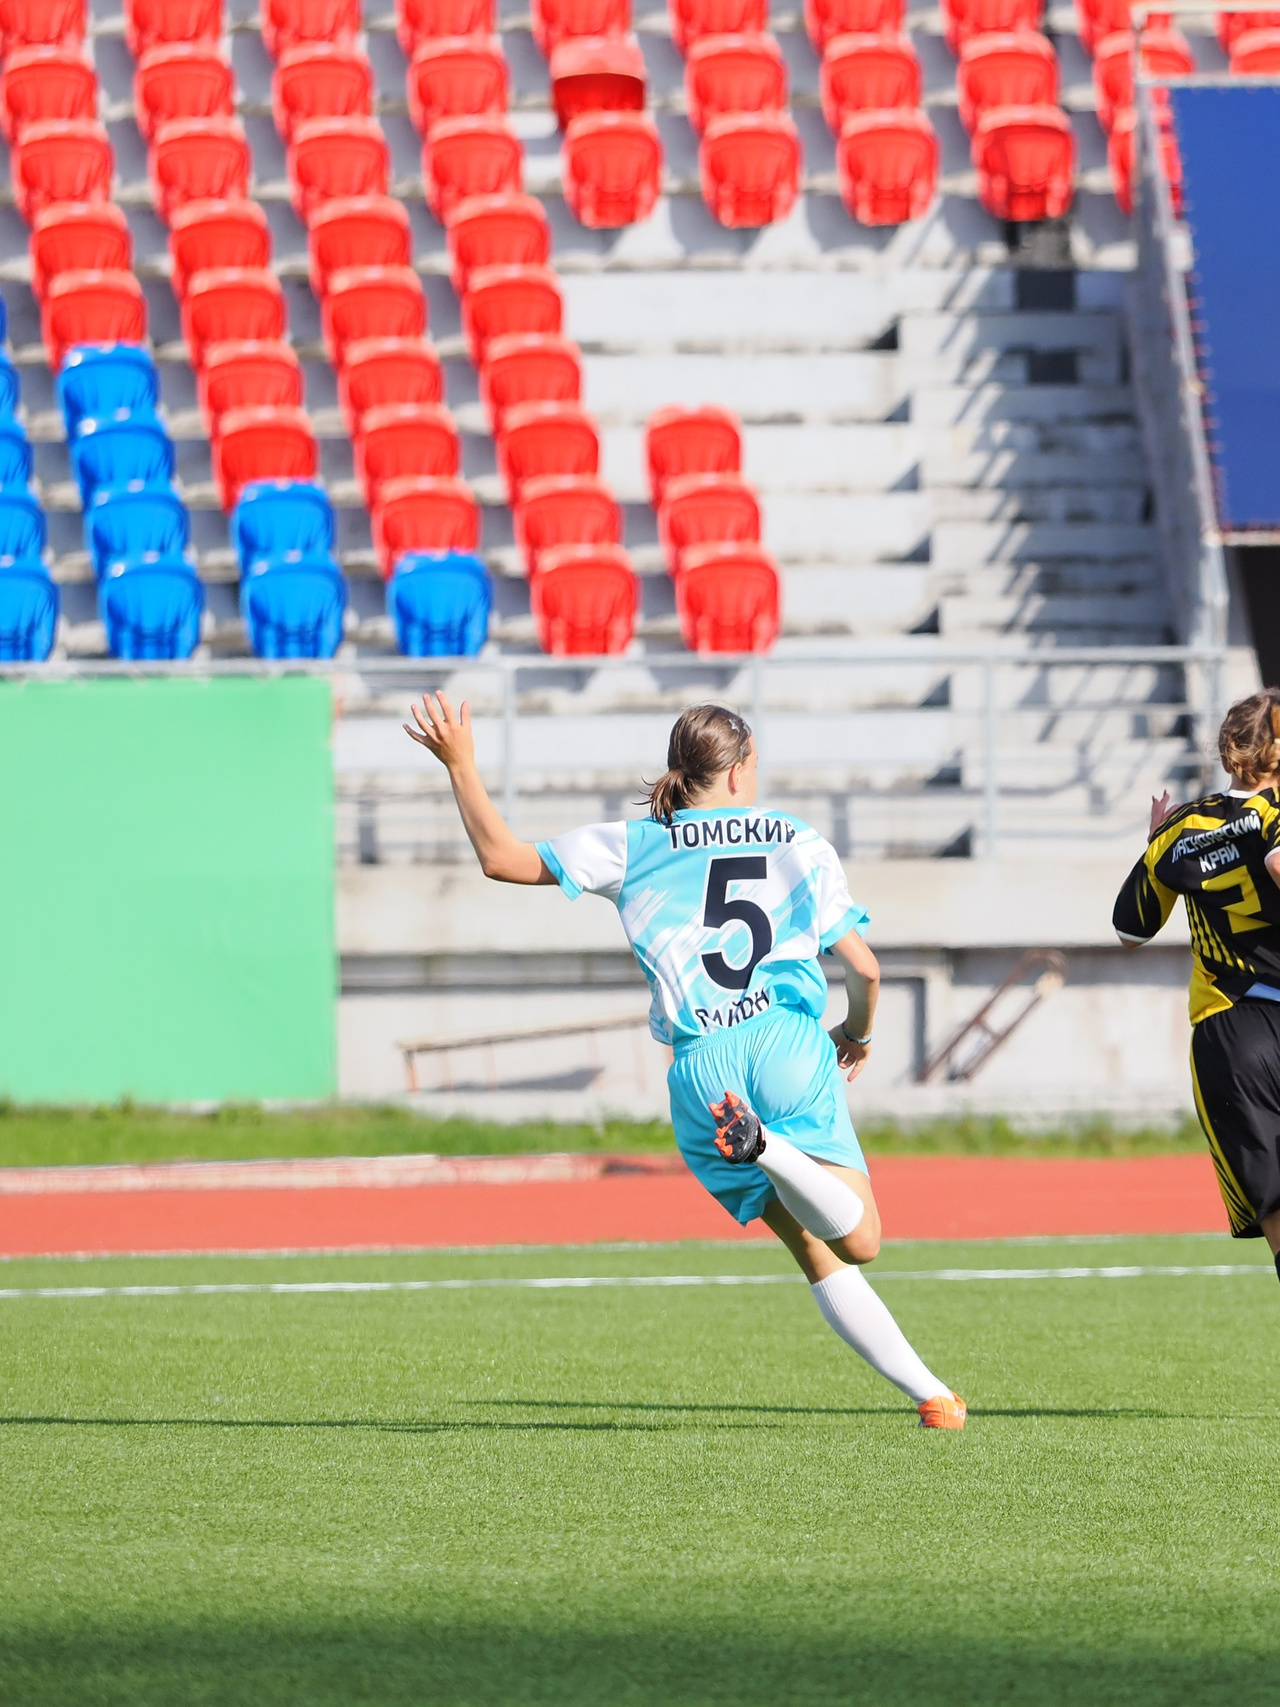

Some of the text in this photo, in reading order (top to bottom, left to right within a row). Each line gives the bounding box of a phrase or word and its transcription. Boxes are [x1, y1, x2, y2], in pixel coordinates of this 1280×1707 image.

[1198, 840, 1241, 873] КРАЙ
[701, 856, 772, 990] 5
[1201, 865, 1273, 934] 2
